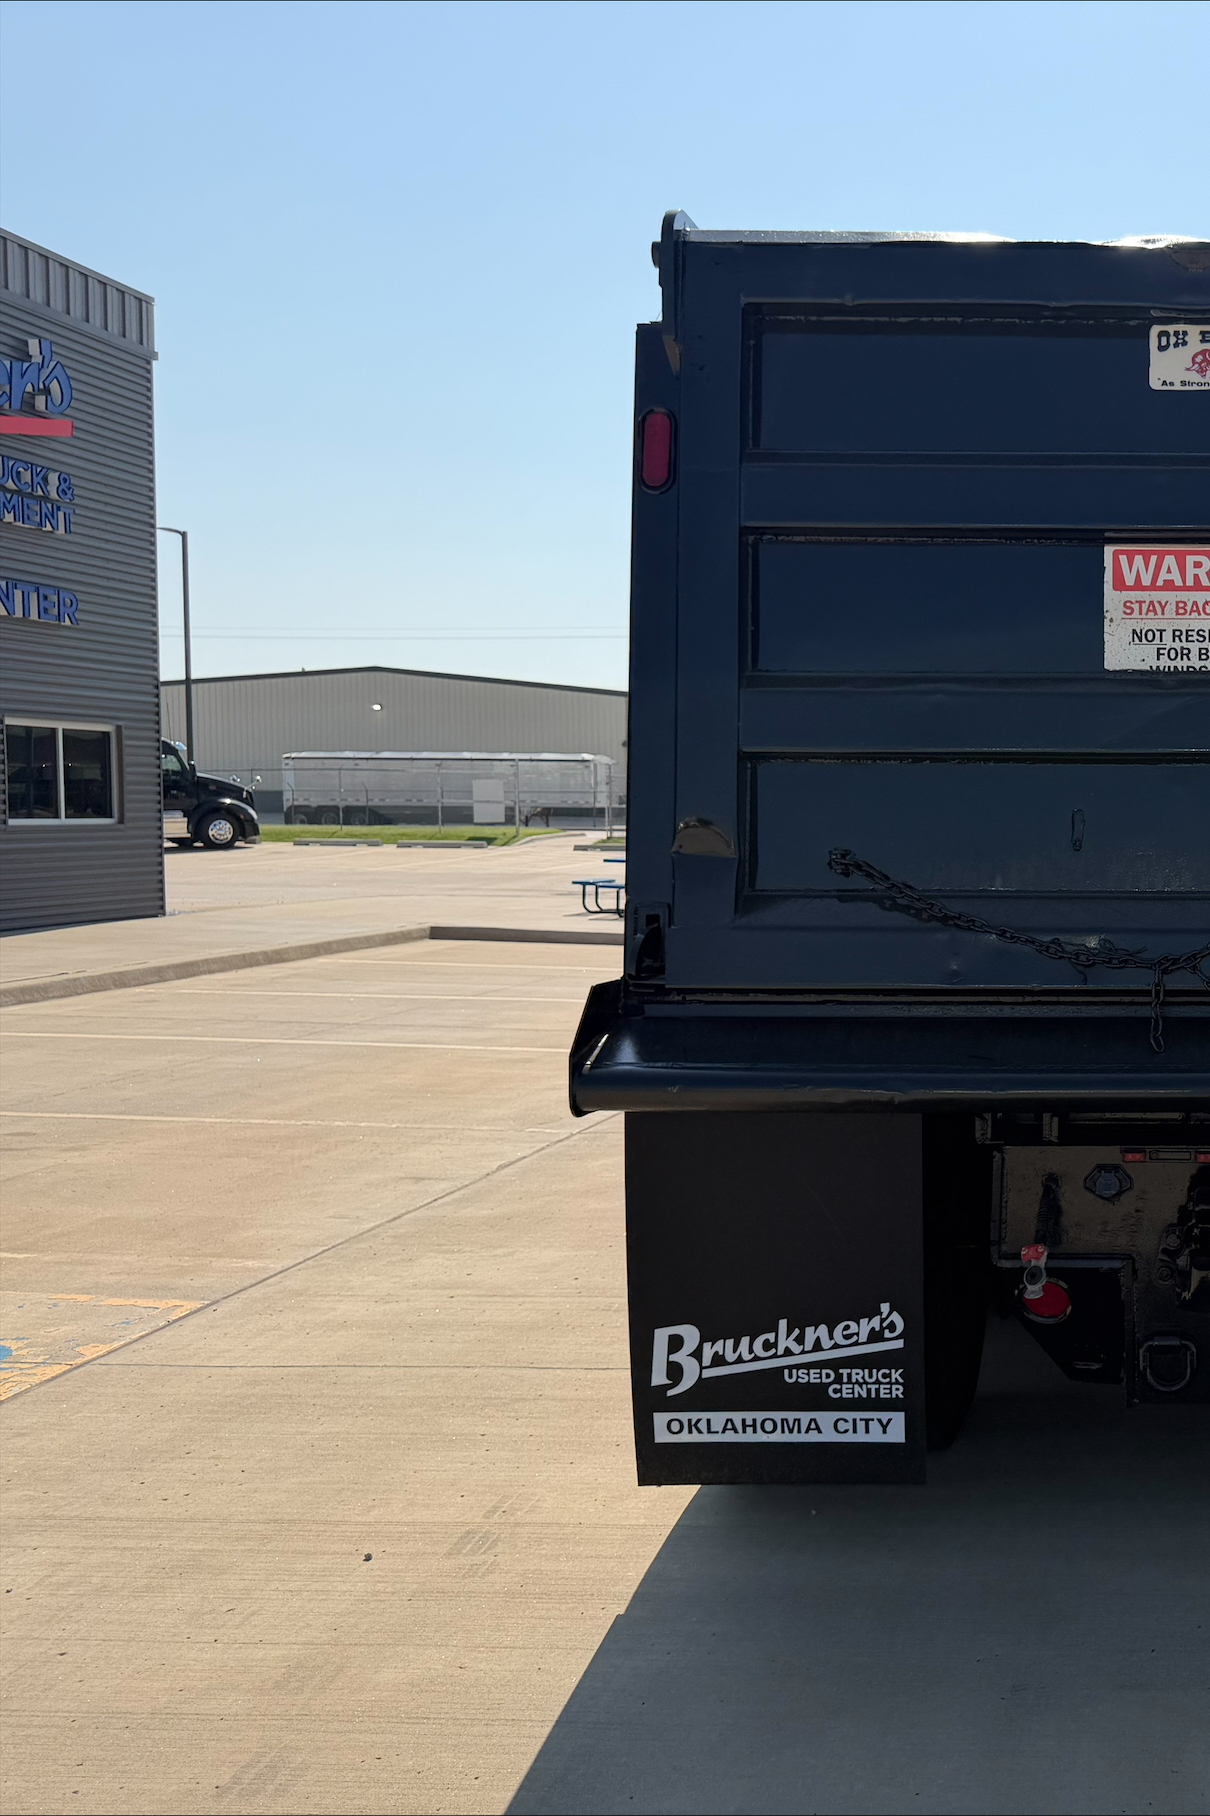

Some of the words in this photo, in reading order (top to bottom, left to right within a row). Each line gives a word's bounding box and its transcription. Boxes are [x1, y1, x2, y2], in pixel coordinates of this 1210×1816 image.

[1157, 330, 1189, 352] OX
[56, 472, 75, 502] &
[1122, 600, 1172, 617] STAY
[1132, 628, 1166, 643] NOT
[1156, 647, 1191, 661] FOR
[651, 1302, 904, 1396] Bruckner's
[784, 1368, 835, 1383] USED
[839, 1368, 904, 1383] TRUCK
[828, 1384, 904, 1398] CENTER
[666, 1417, 822, 1434] OKLAHOMA
[833, 1417, 893, 1434] CITY
